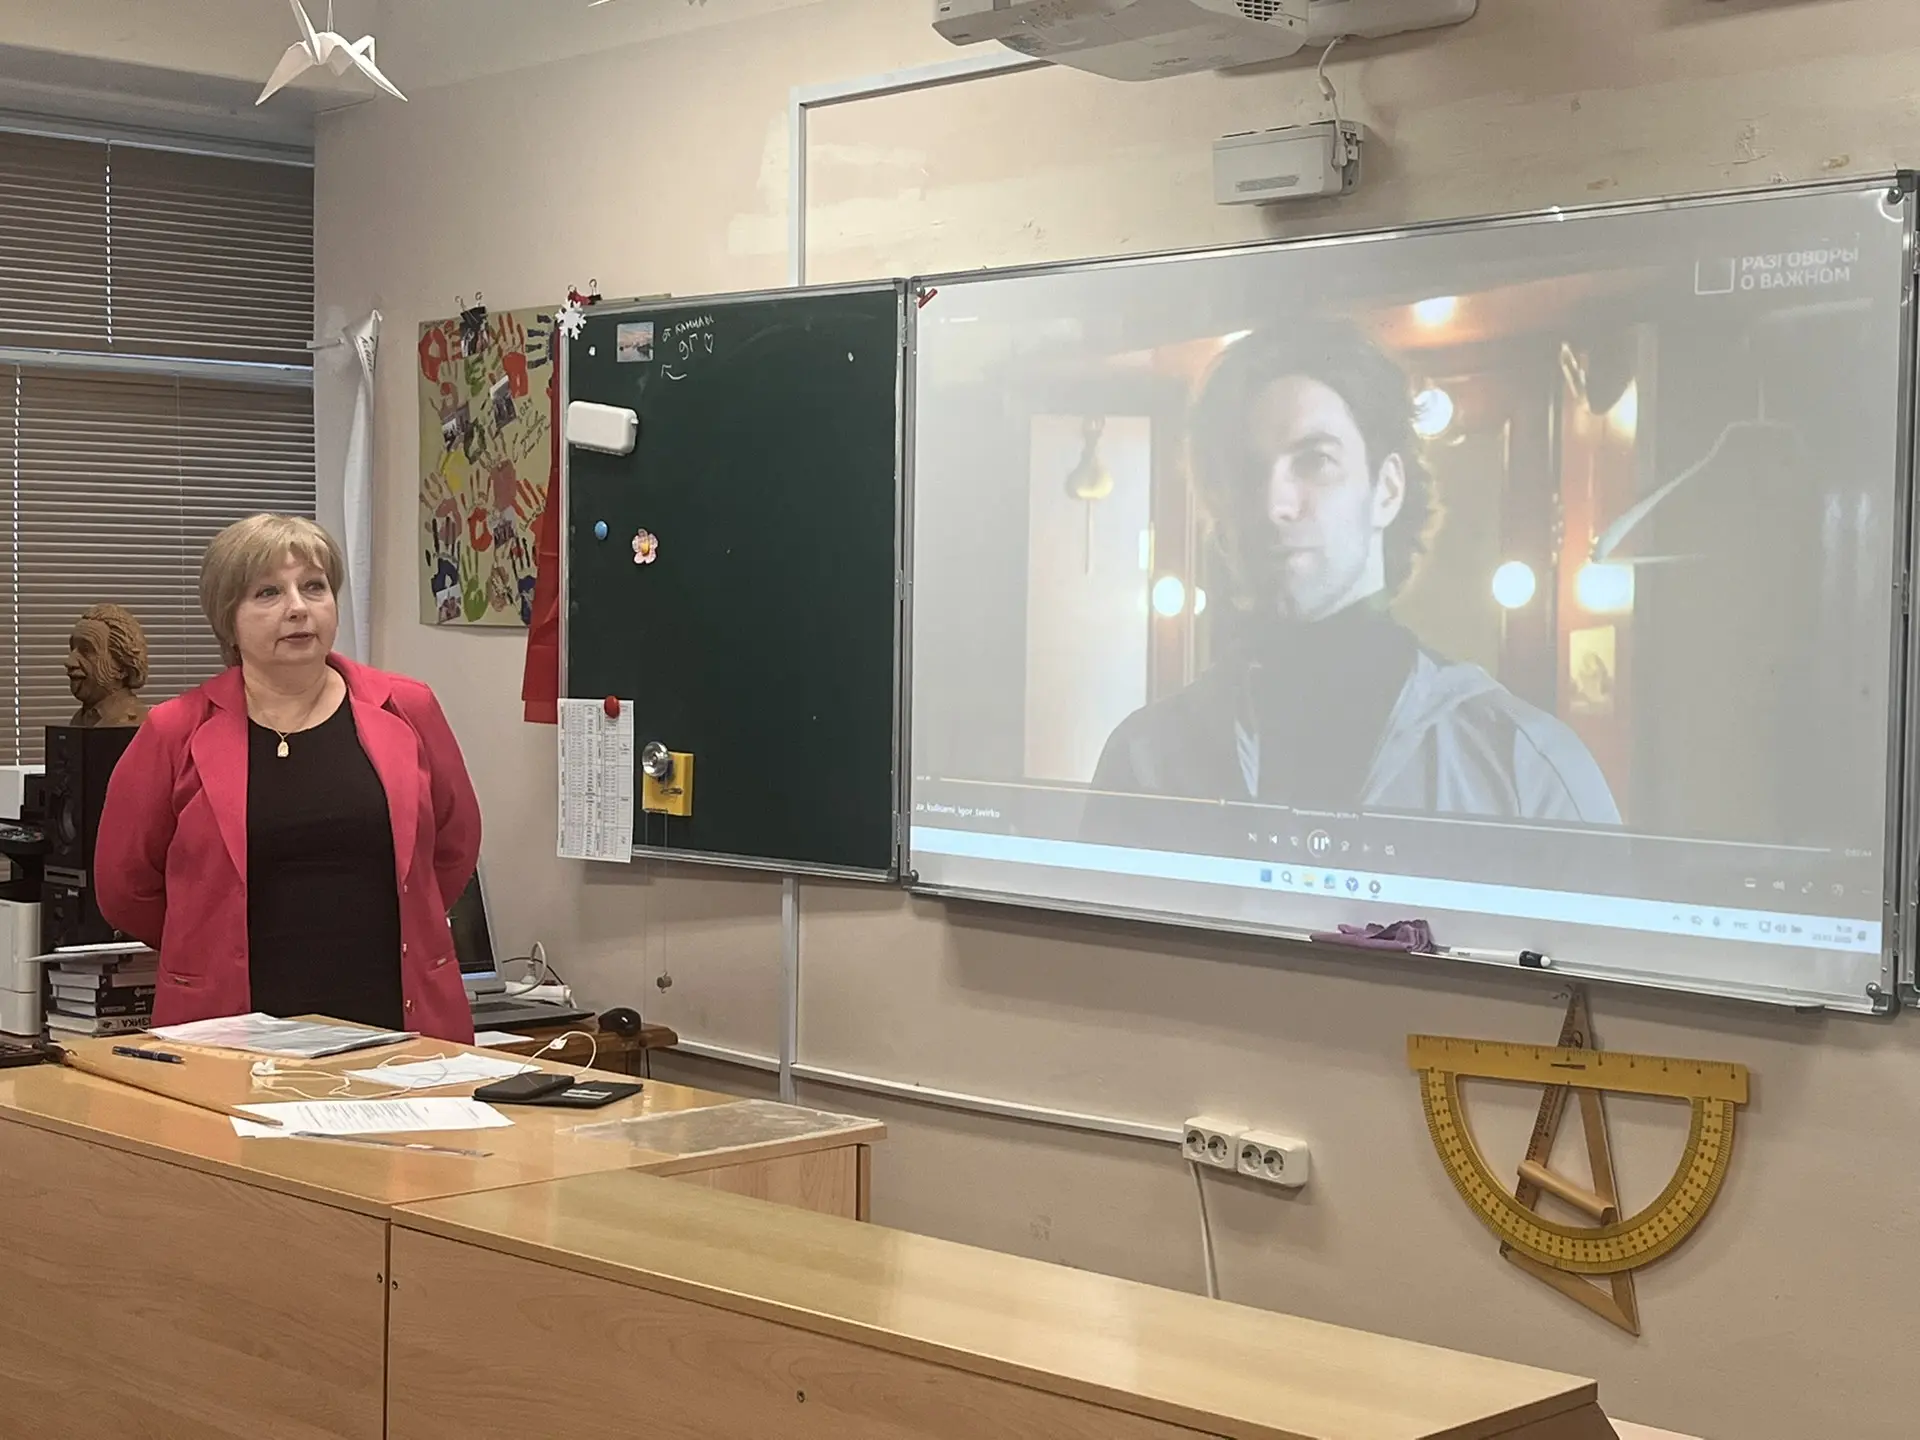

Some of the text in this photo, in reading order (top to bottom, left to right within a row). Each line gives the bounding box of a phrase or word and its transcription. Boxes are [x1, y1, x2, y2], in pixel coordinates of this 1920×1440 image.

[1742, 248, 1859, 271] РАЗГОВОРЫ
[1740, 266, 1850, 290] О ВАЖНОМ
